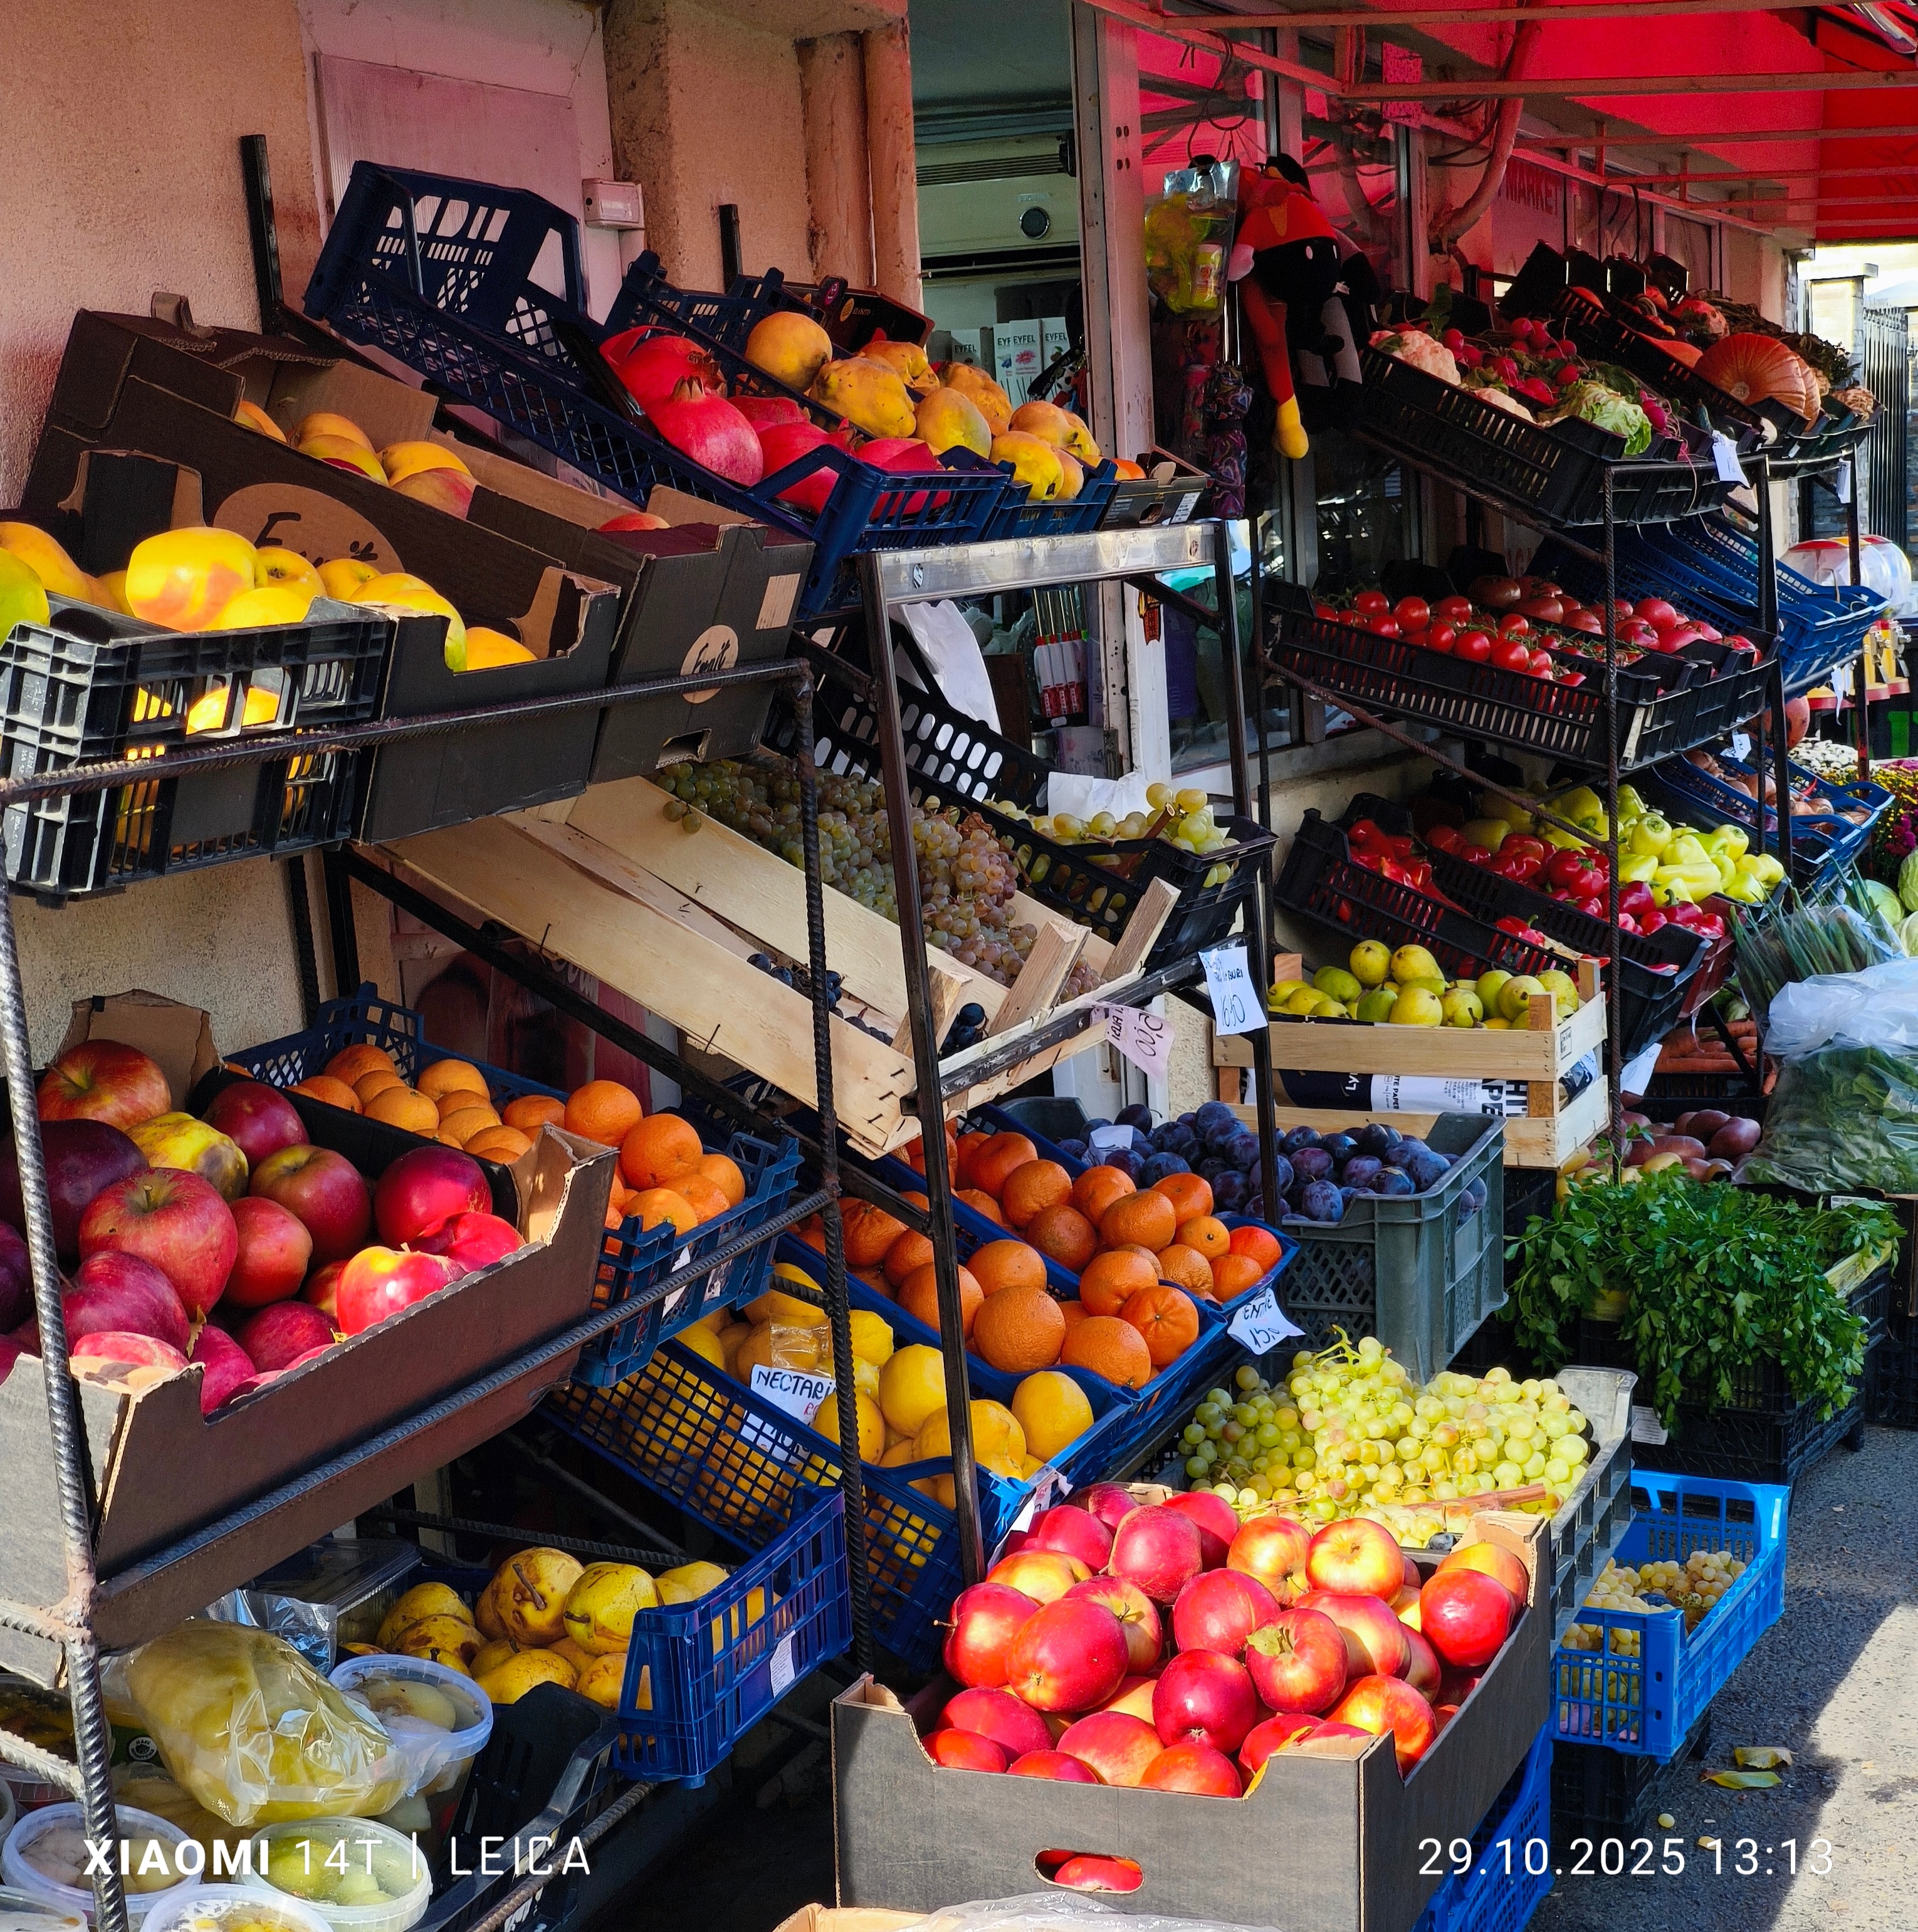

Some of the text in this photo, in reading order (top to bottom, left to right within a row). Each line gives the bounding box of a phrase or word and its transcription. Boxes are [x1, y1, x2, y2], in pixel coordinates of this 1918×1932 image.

[997, 337, 1011, 345] EYF
[1013, 335, 1035, 345] EYFEL
[1045, 332, 1067, 342] EYFEL
[955, 344, 977, 353] EYFEL
